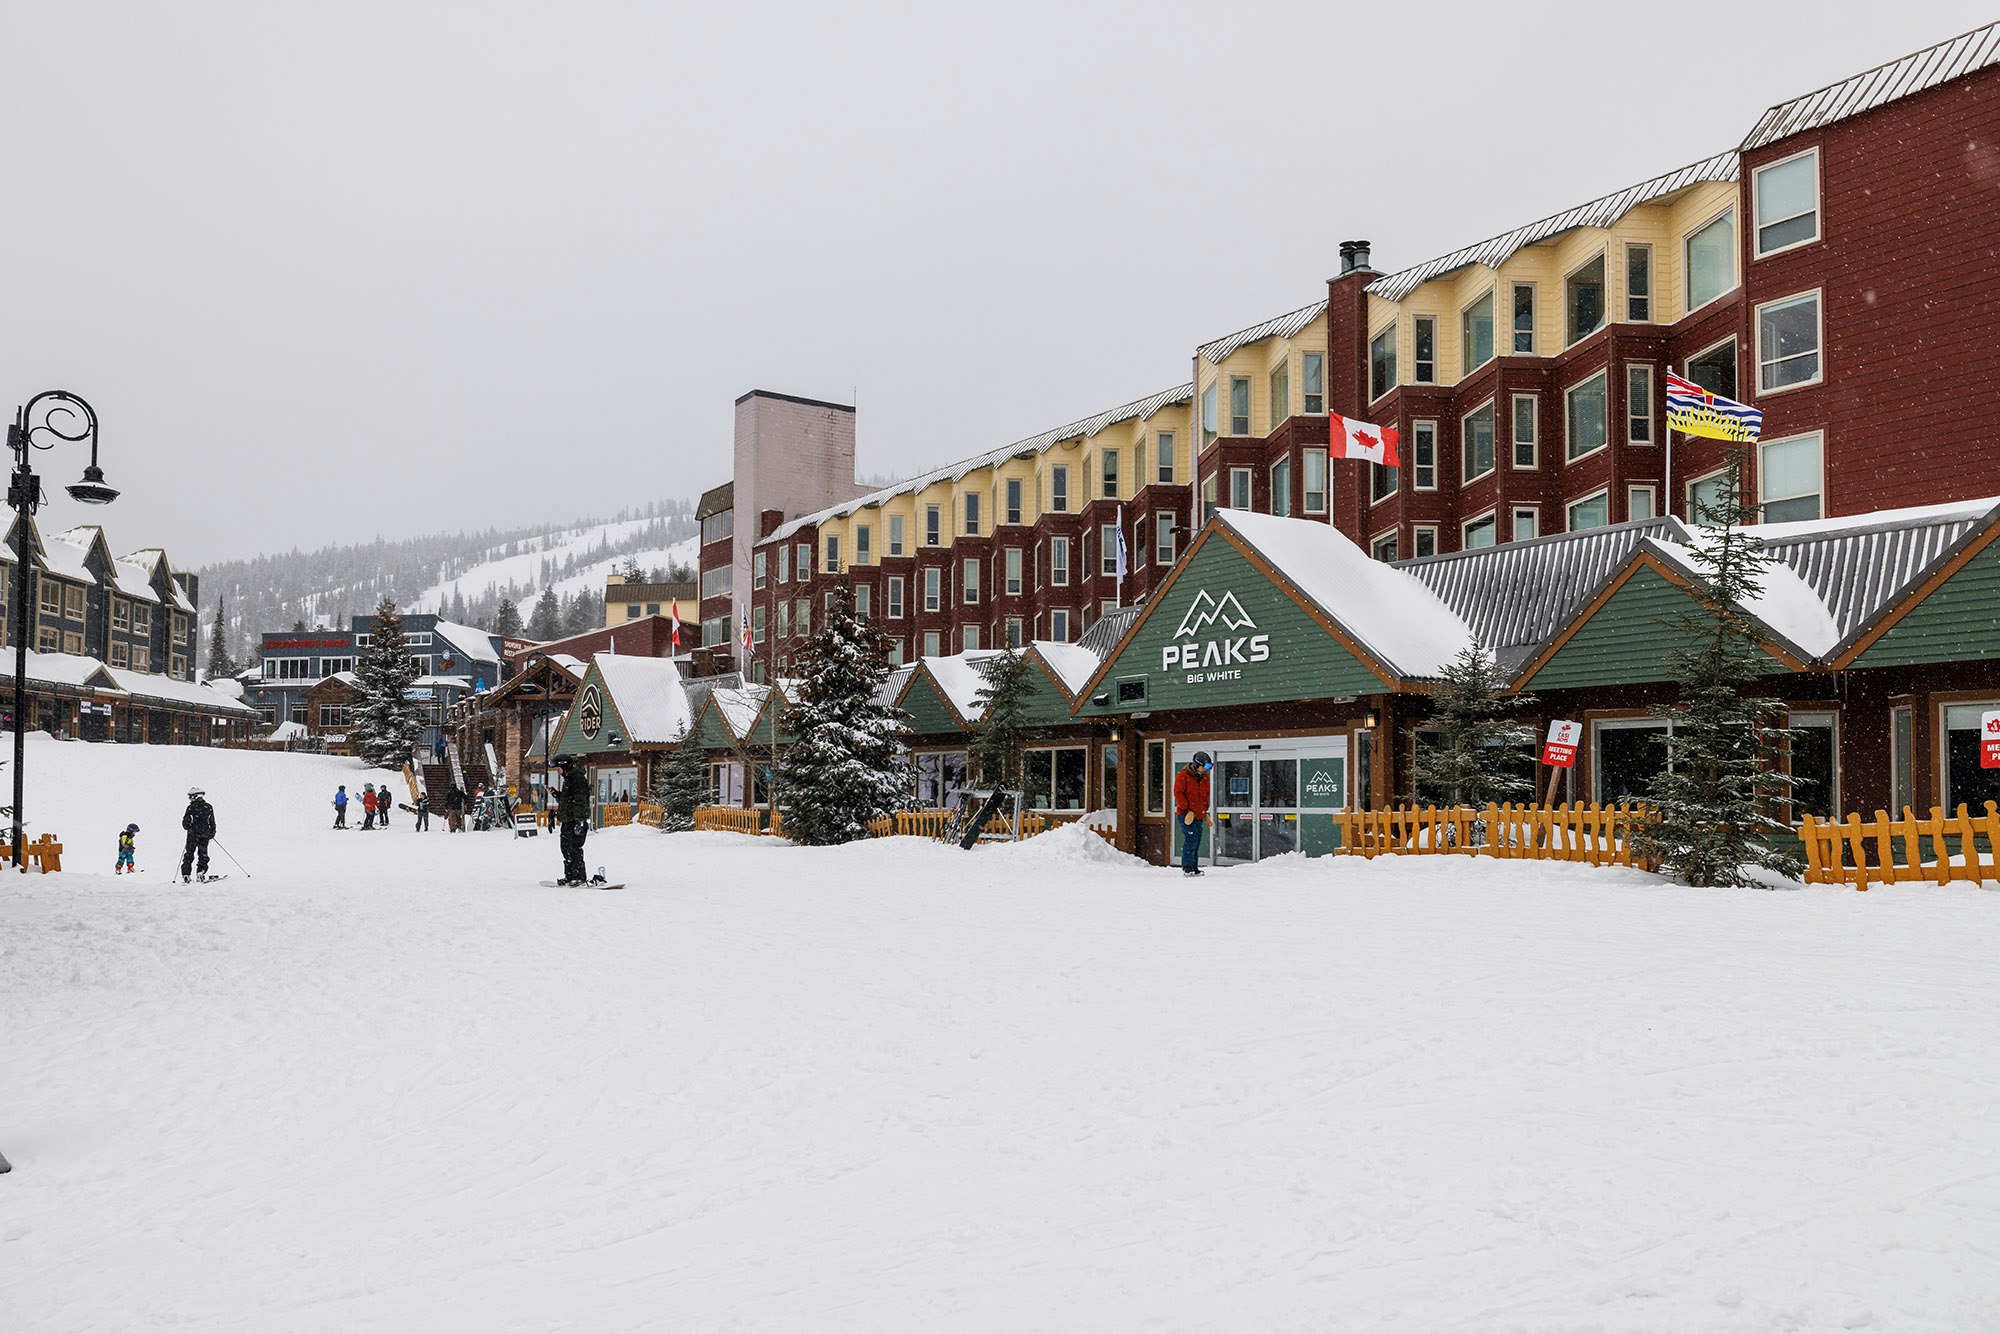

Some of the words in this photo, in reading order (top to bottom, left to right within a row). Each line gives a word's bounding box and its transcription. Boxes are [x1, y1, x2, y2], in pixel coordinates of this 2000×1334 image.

[1162, 634, 1270, 671] PEAKS
[1186, 674, 1204, 684] BIG
[1206, 670, 1241, 681] WHITE
[580, 717, 601, 730] RIDER
[1548, 746, 1573, 755] MEETING
[1550, 753, 1568, 762] PLACE
[1306, 784, 1338, 792] PEAKS
